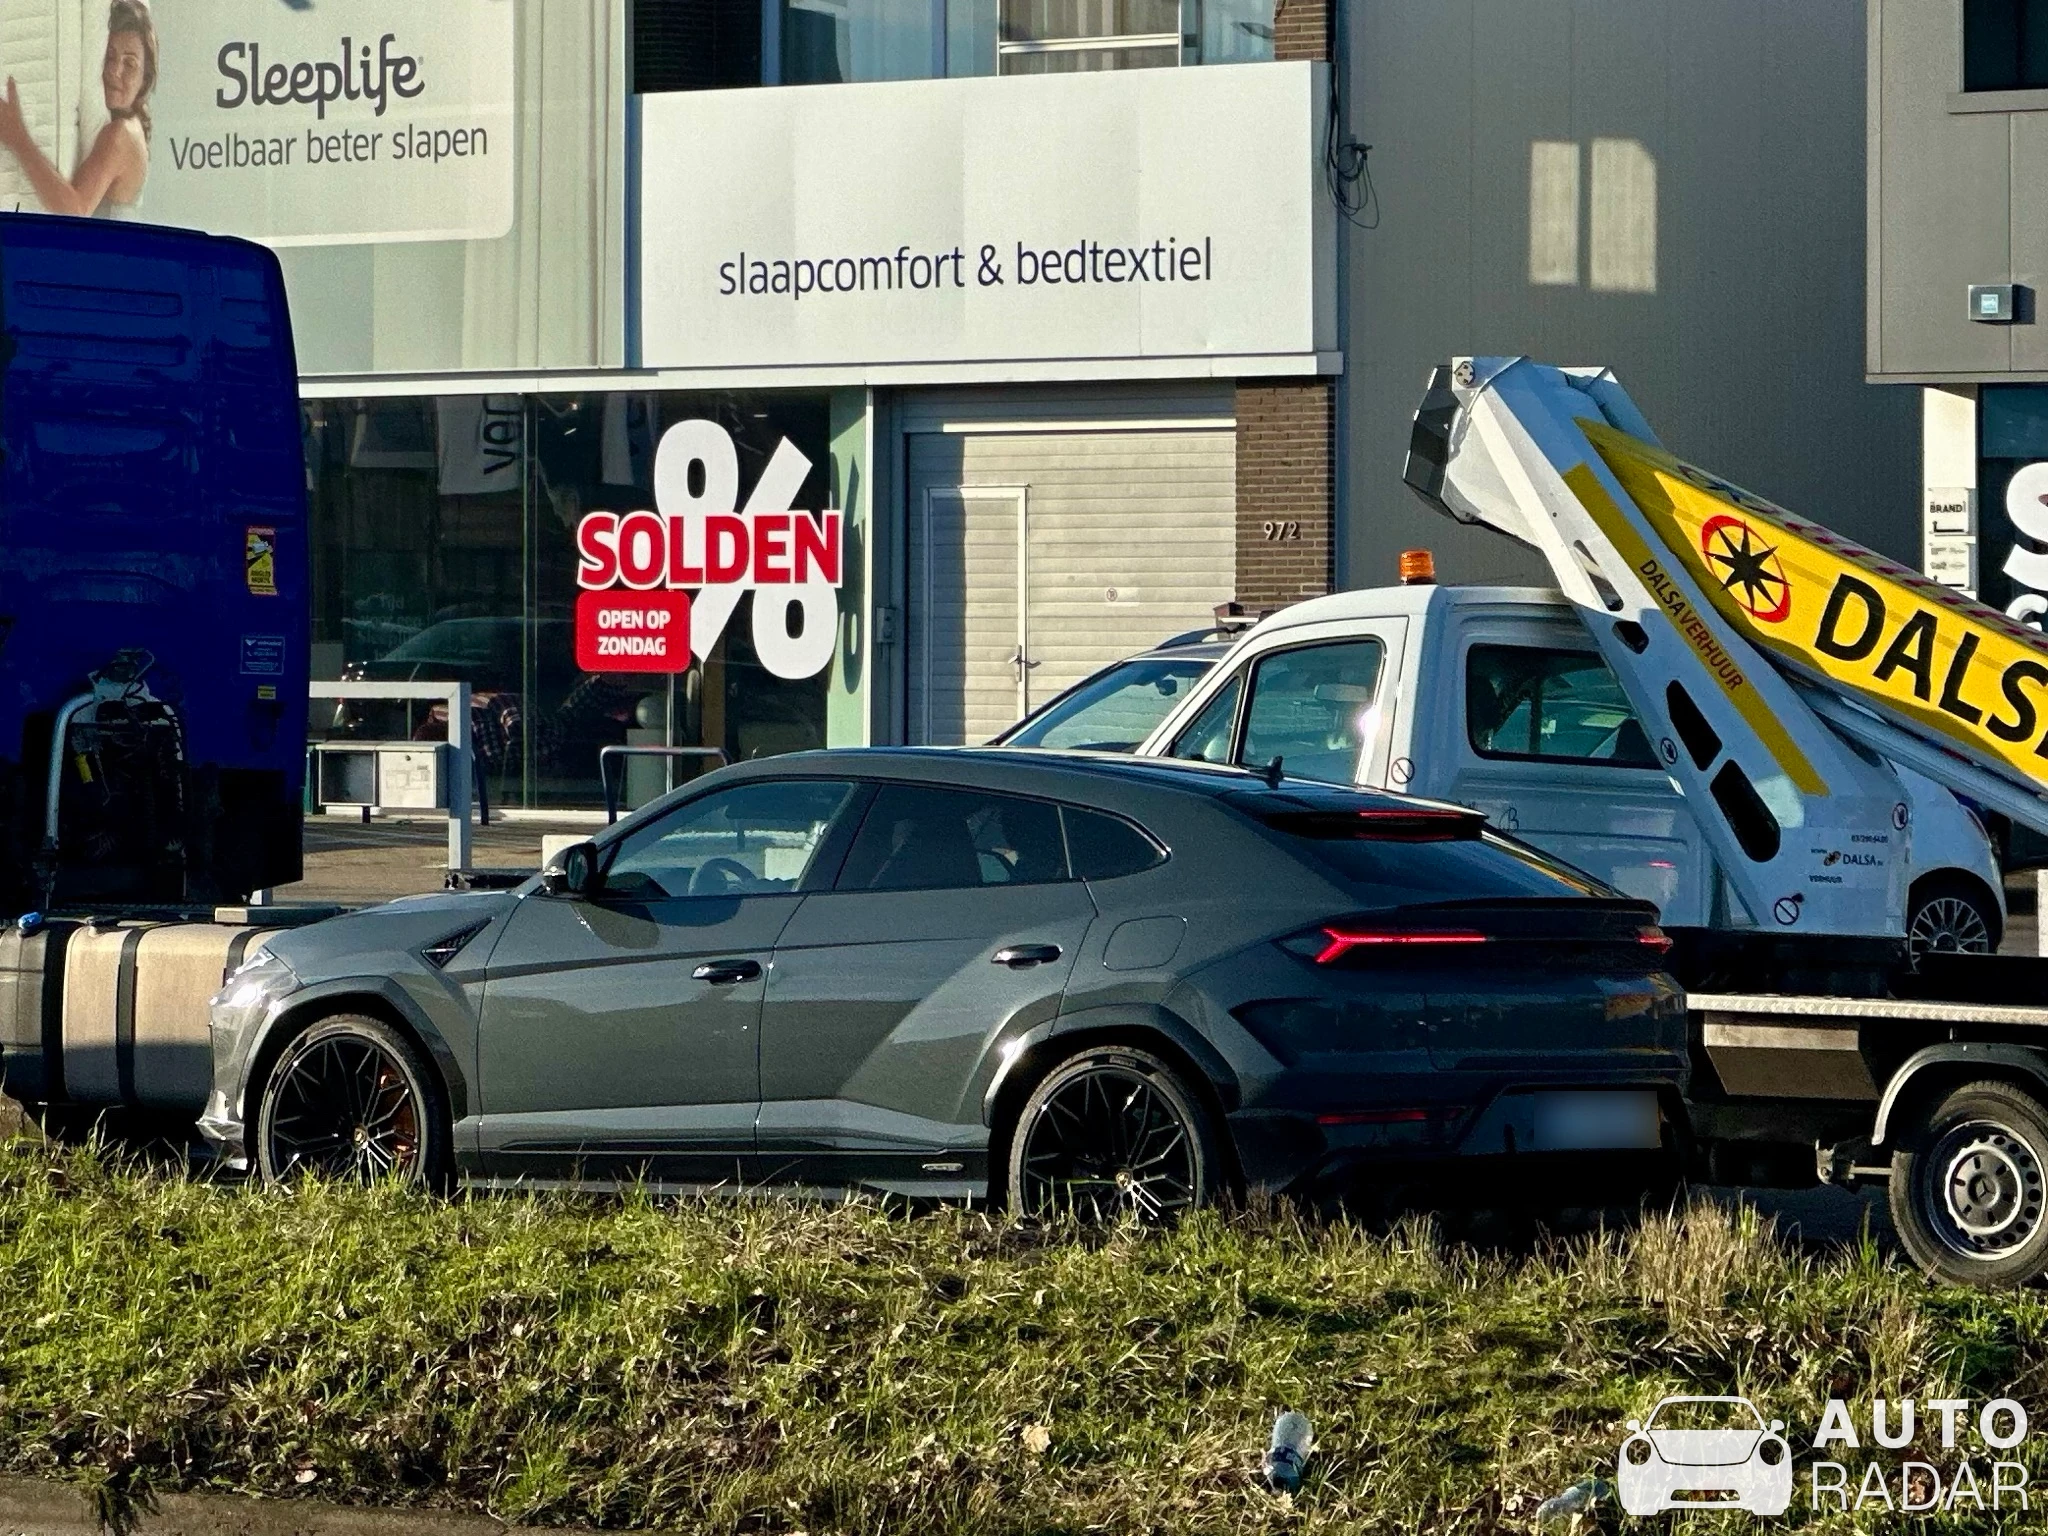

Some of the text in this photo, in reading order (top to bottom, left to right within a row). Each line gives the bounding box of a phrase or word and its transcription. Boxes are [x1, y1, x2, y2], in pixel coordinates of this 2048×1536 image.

[216, 33, 425, 120] Sleeplife
[169, 123, 487, 170] Voelbaar beter slapen
[719, 236, 1212, 300] slaapcomfort & bedtextiel
[577, 510, 842, 588] SOLDEN
[1263, 521, 1298, 540] 972
[598, 610, 671, 630] OPEN OP
[597, 636, 666, 656] ZONDAG
[1814, 572, 2048, 760] DALS
[1843, 854, 1876, 866] DALSA
